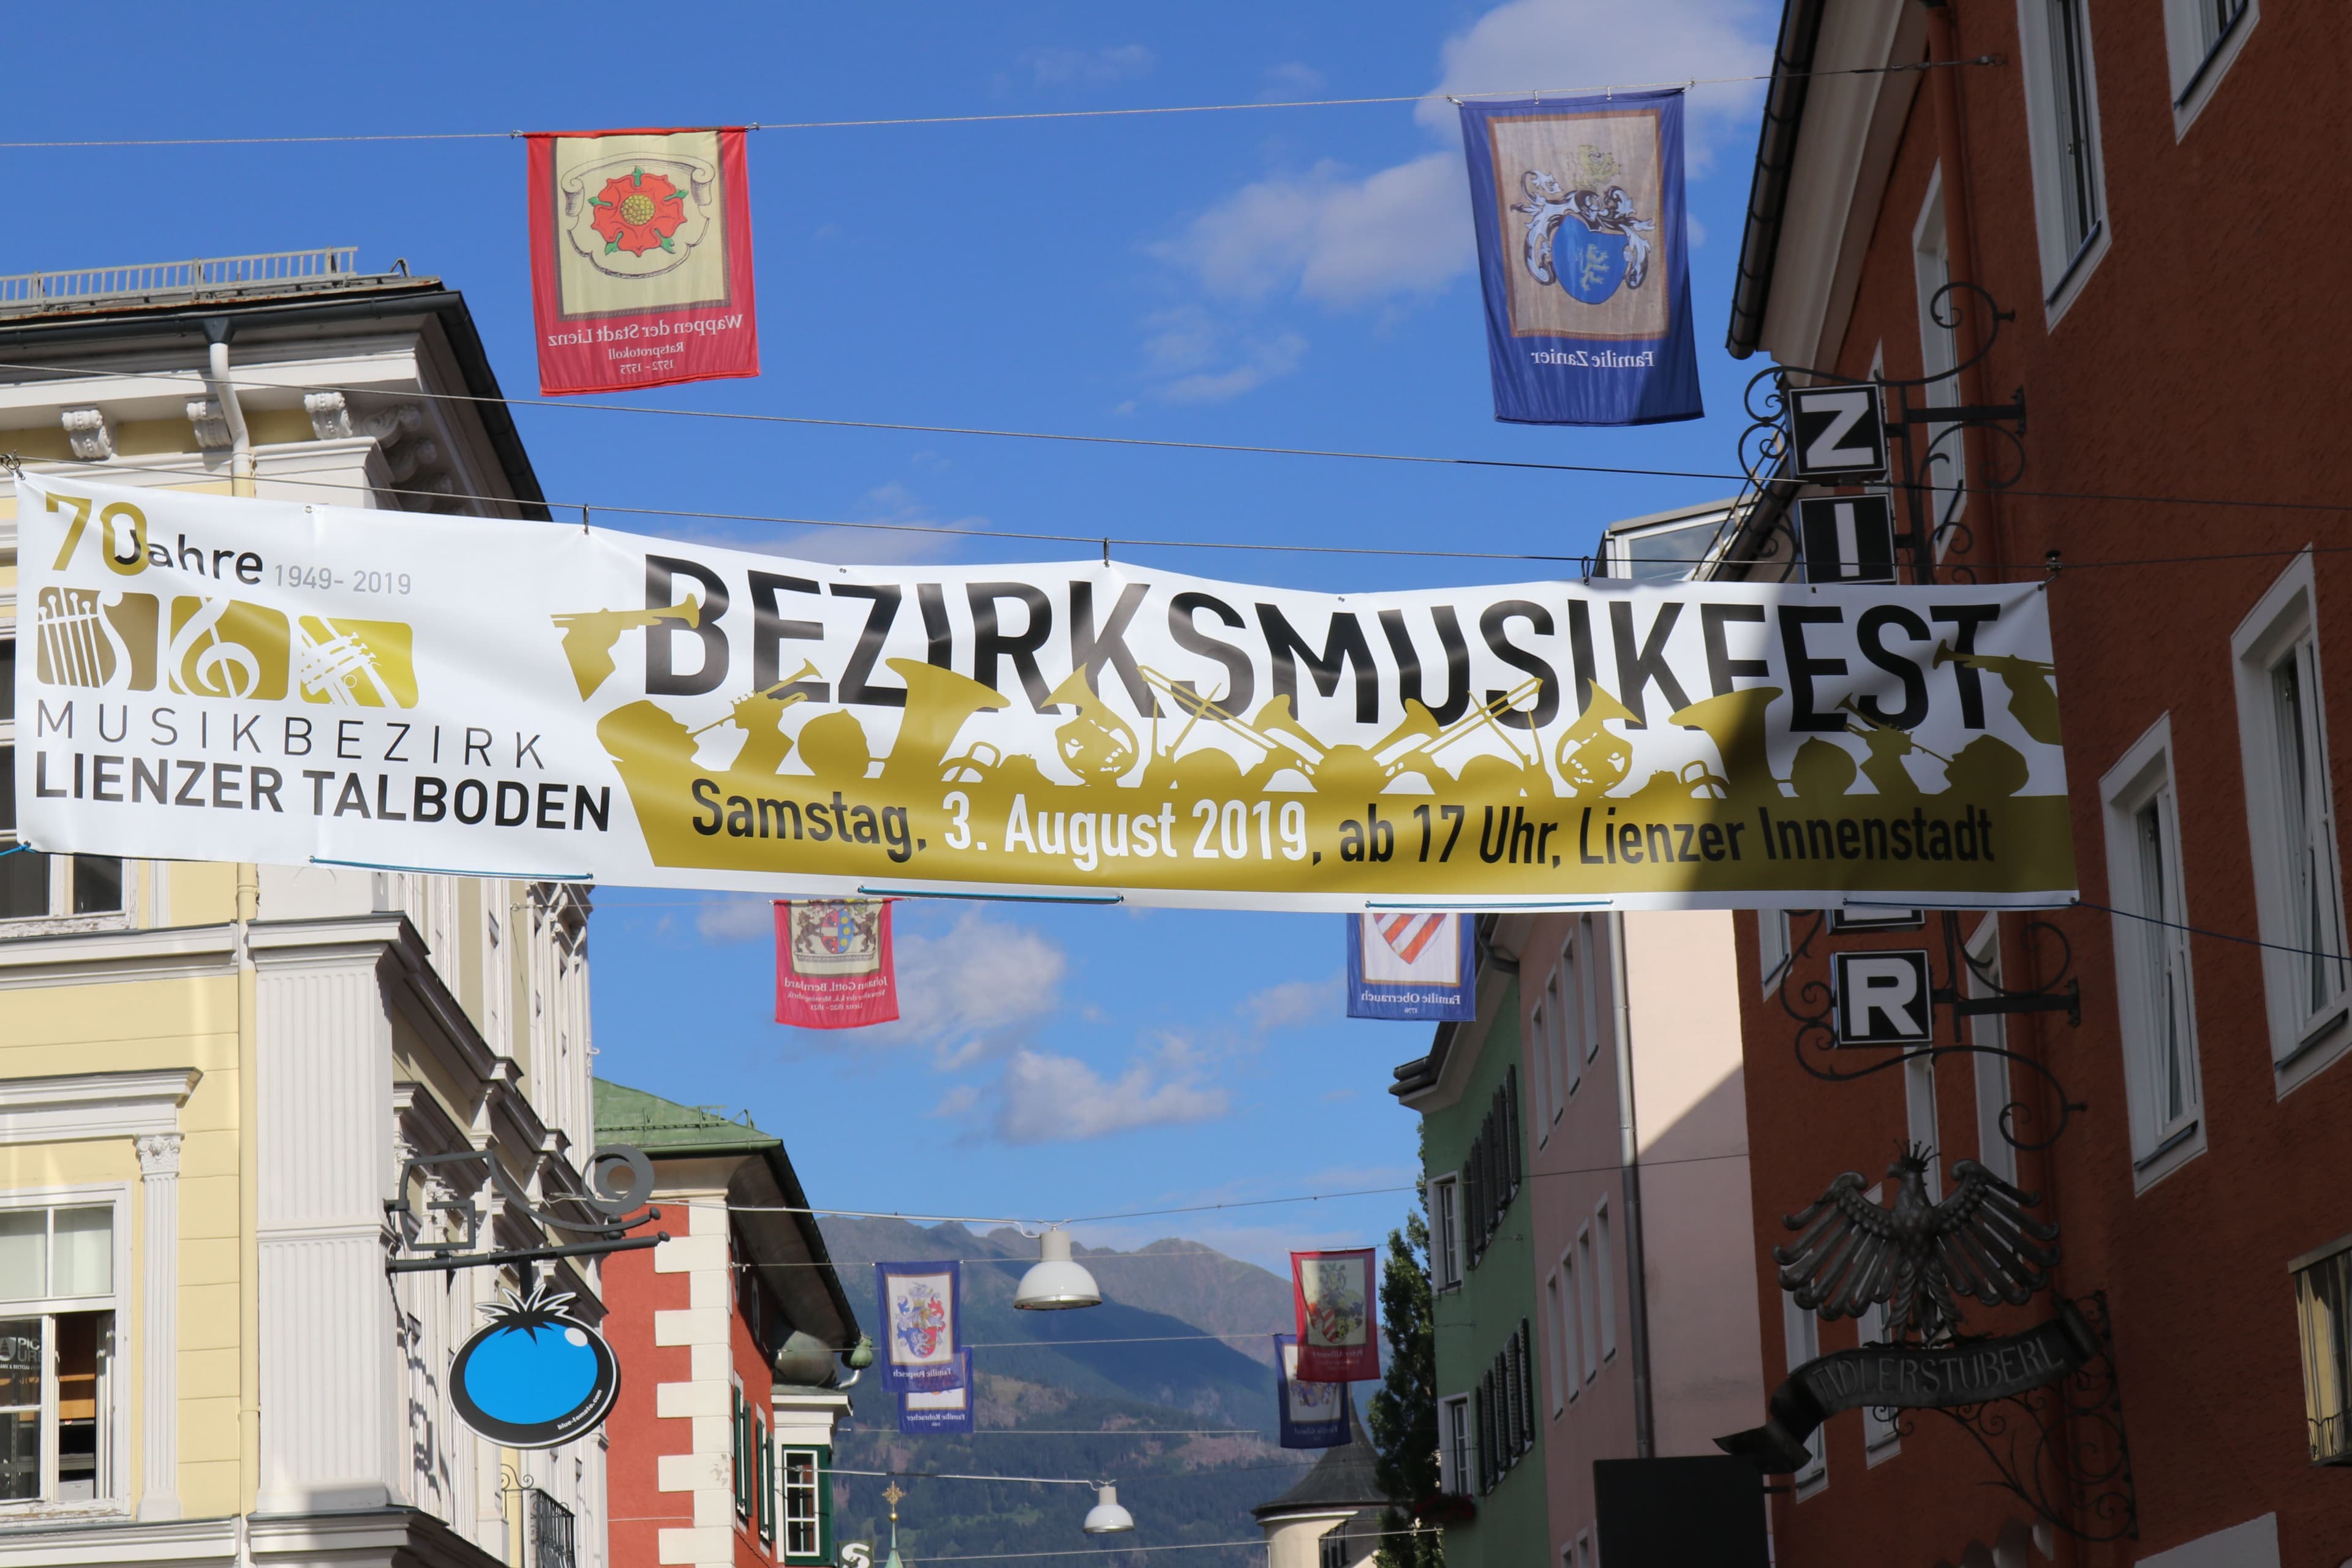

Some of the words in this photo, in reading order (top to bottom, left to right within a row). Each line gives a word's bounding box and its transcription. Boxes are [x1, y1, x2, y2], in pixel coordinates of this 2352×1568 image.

[45, 492, 148, 577] 70
[114, 529, 264, 586] Jahre
[353, 570, 412, 596] 2019
[645, 554, 2001, 733] BEZIRKSMUSIKFEST
[38, 699, 545, 770] MUSIKBEZIRK
[36, 750, 284, 813] LIENZER
[303, 770, 610, 832] TALBODEN
[692, 778, 927, 863] Samstag,
[943, 791, 986, 851] 3.
[1005, 794, 1176, 872] August
[1193, 799, 1321, 867] 2019,
[1339, 809, 1394, 862] ab
[1413, 805, 1465, 863] 17
[1480, 807, 1562, 869] Uhr,
[1580, 807, 1746, 865] Lienzer
[1760, 805, 1994, 862] Innenstadt
[557, 1389, 603, 1430] blue-tomato.com
